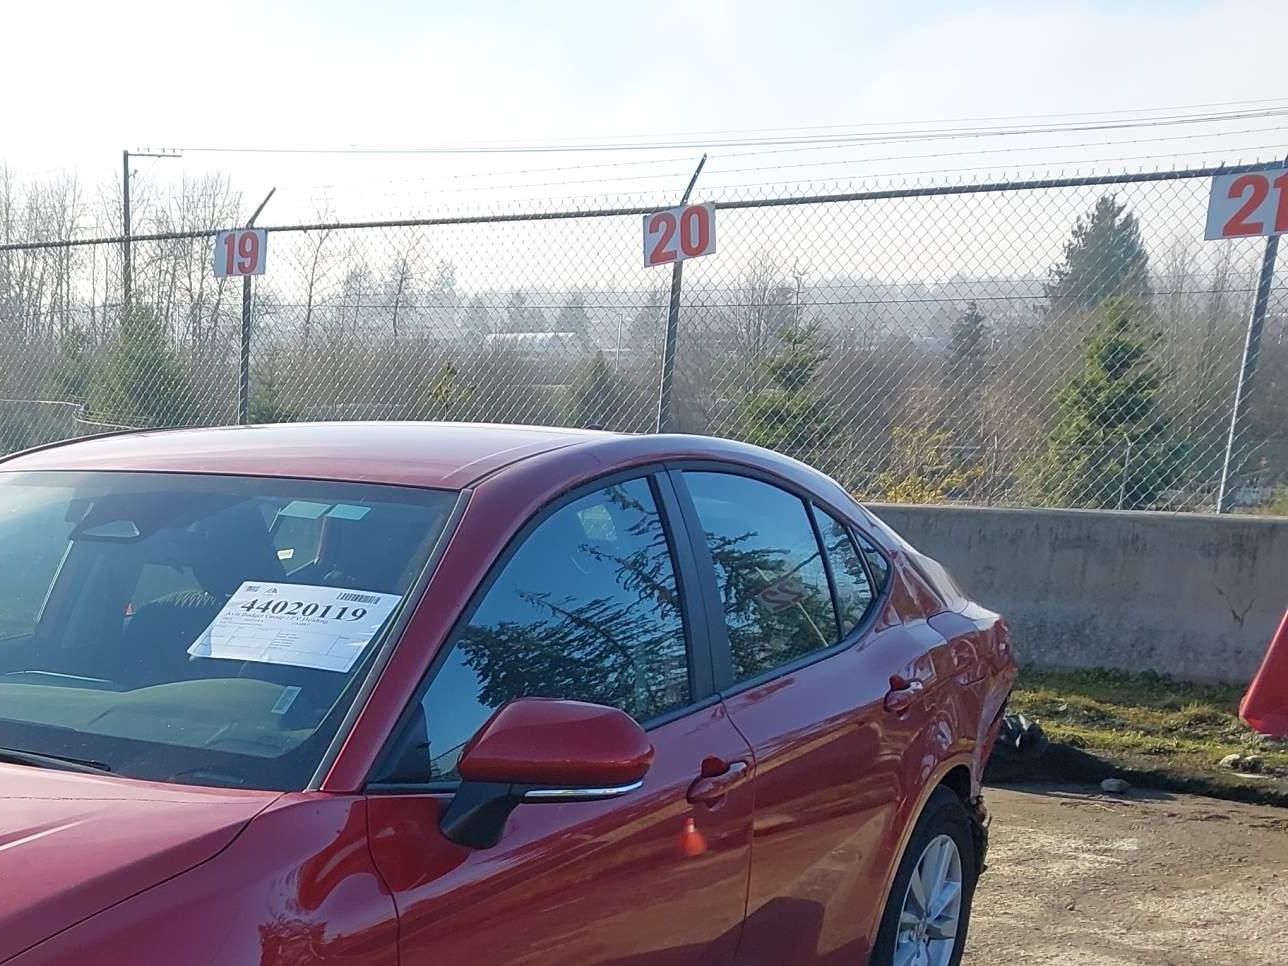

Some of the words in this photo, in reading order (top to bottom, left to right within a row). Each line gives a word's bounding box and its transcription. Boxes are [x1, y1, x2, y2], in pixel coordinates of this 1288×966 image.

[1222, 173, 1288, 236] 21
[223, 231, 259, 275] 19
[649, 205, 710, 264] 20
[241, 598, 368, 622] 44020119
